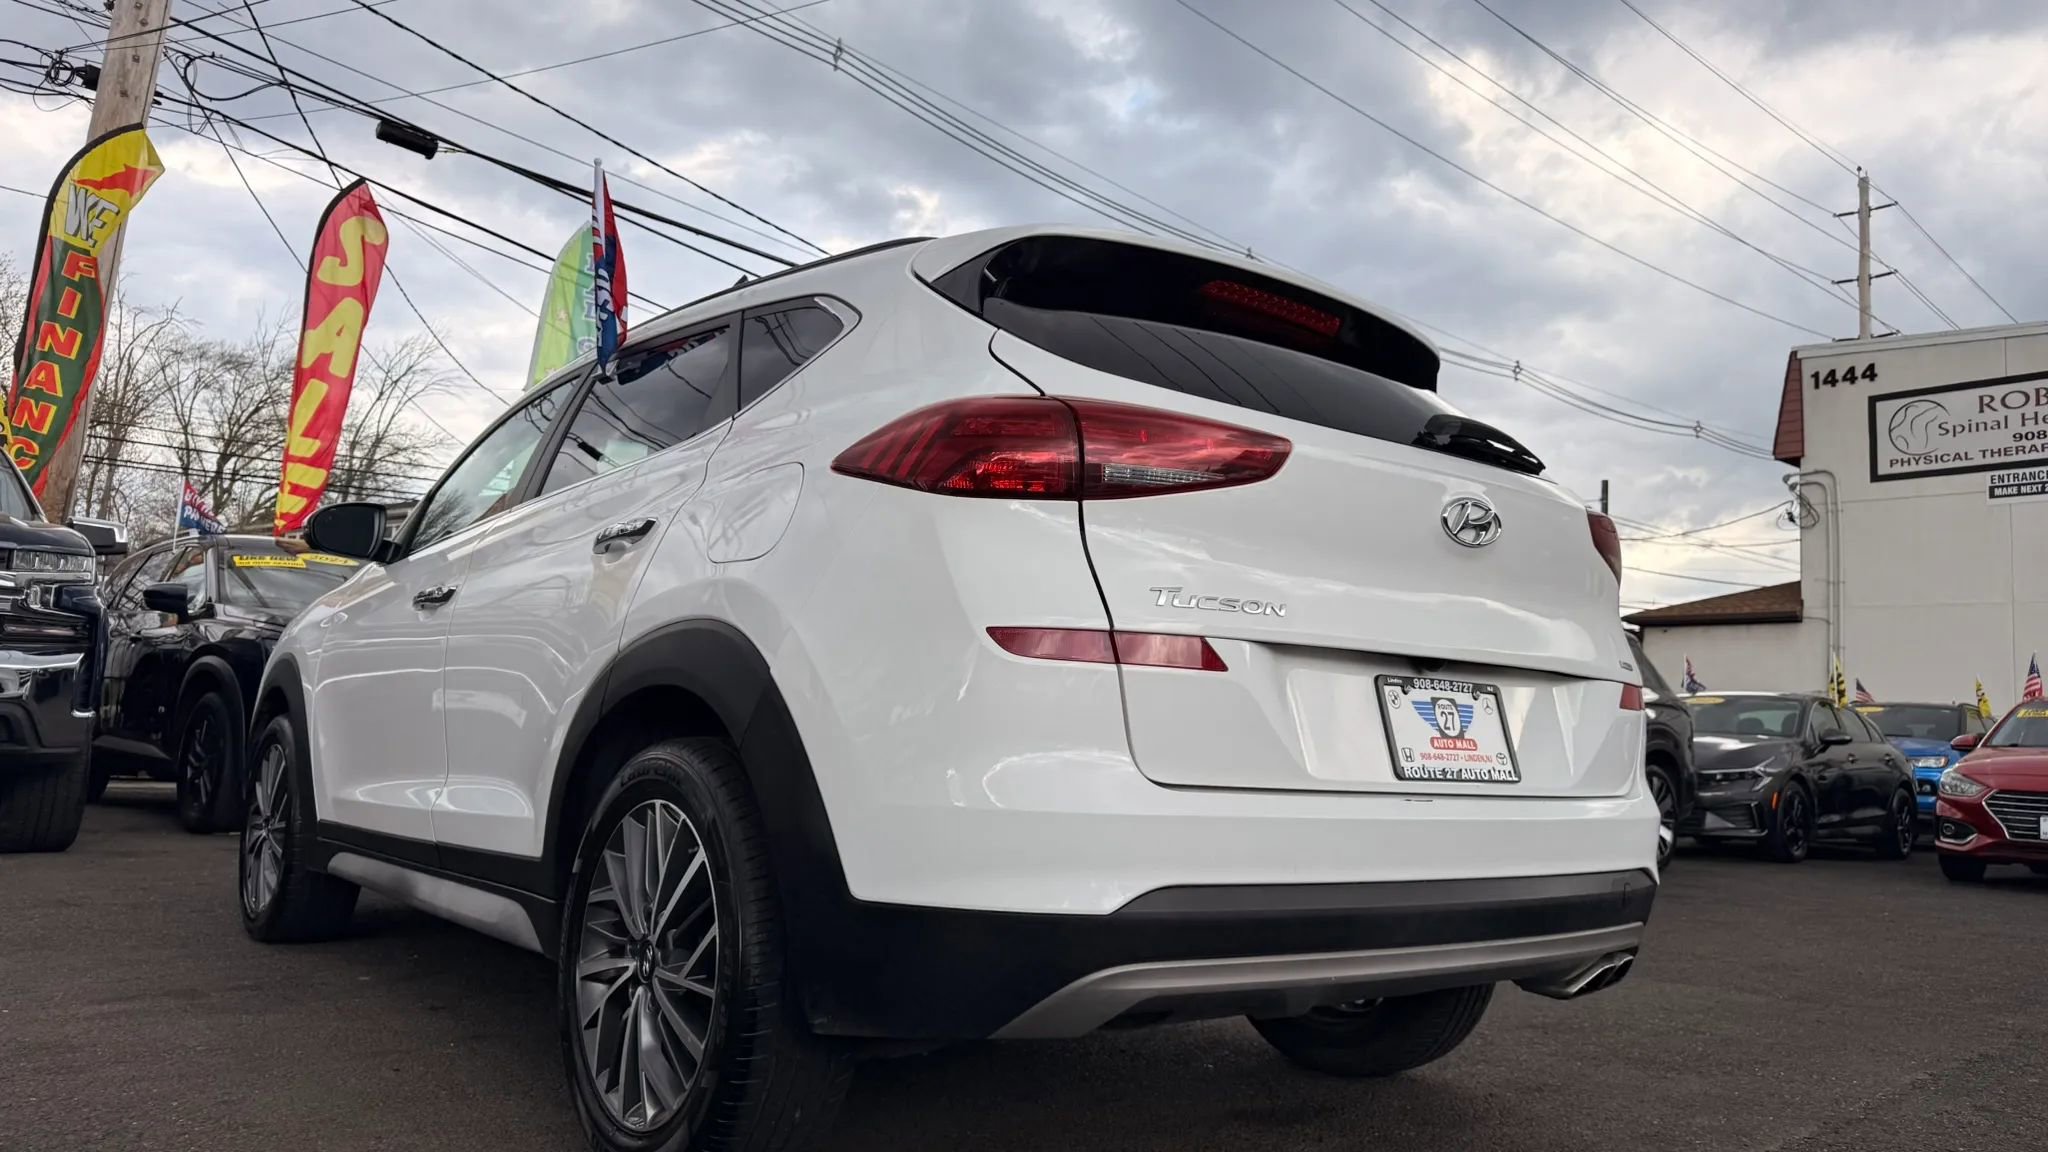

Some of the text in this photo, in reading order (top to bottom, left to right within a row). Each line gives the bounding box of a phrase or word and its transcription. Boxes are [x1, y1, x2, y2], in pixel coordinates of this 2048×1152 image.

[66, 182, 120, 248] WE
[275, 216, 386, 529] SALE
[1811, 363, 1878, 390] 1444
[1937, 414, 2009, 438] Spinal
[1889, 451, 1974, 468] PHYSICAL
[1994, 486, 2019, 497] MAKE
[2020, 483, 2043, 495] NEXT
[1149, 586, 1287, 617] TUCSON
[1413, 678, 1473, 693] 908-648-2727
[1440, 711, 1456, 731] 27
[1433, 739, 1477, 750] AUTO MALL
[1404, 766, 1519, 781] ROUTE 27 AUTO MALL
